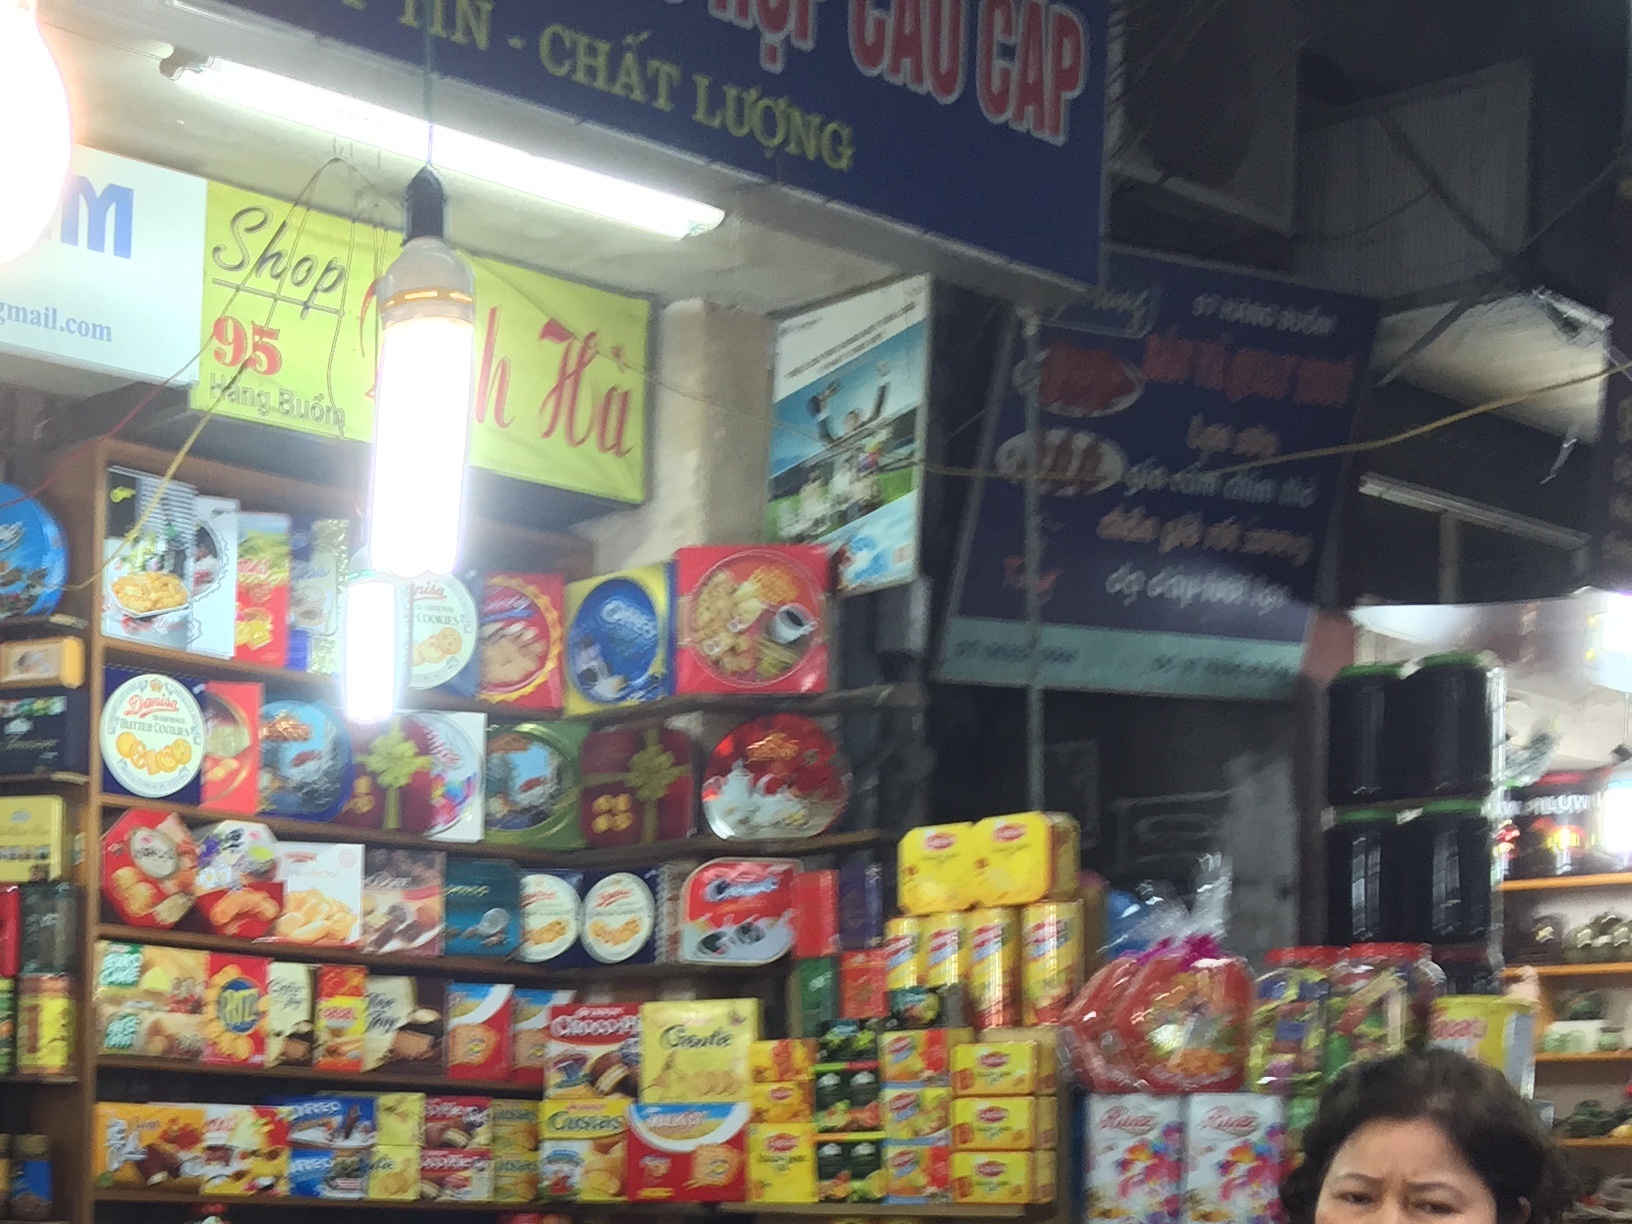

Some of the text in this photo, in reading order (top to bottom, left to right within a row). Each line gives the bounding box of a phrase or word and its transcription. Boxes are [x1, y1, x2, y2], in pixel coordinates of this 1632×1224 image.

[539, 24, 681, 112] CHẤT
[692, 74, 855, 172] LƯỢNG
[211, 205, 346, 321] Shop
[212, 315, 283, 377] 95
[208, 371, 346, 429] Hàng Buồm
[123, 694, 180, 718] Danisa
